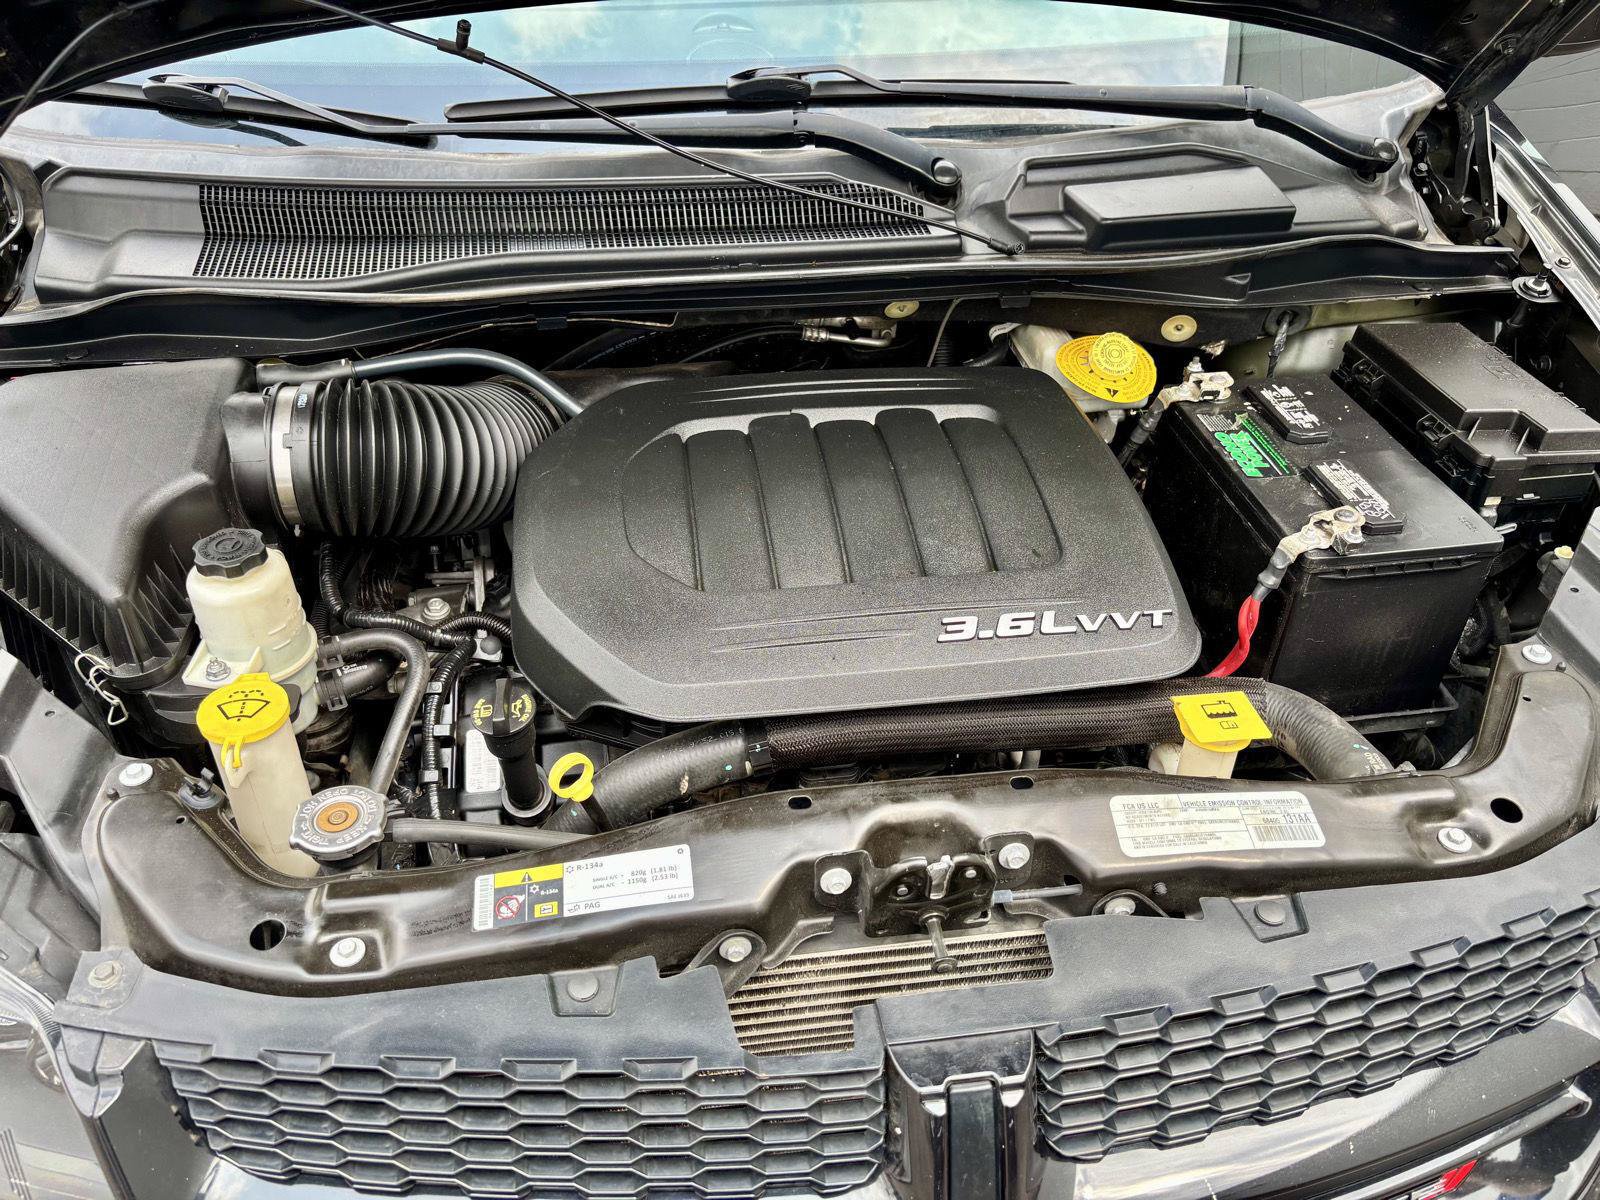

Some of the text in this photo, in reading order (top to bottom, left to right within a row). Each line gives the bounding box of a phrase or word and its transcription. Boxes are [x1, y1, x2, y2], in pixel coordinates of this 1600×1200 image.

[937, 608, 1173, 642] 3.6L VVT
[576, 862, 603, 871] R-134a
[584, 902, 600, 910] PAG
